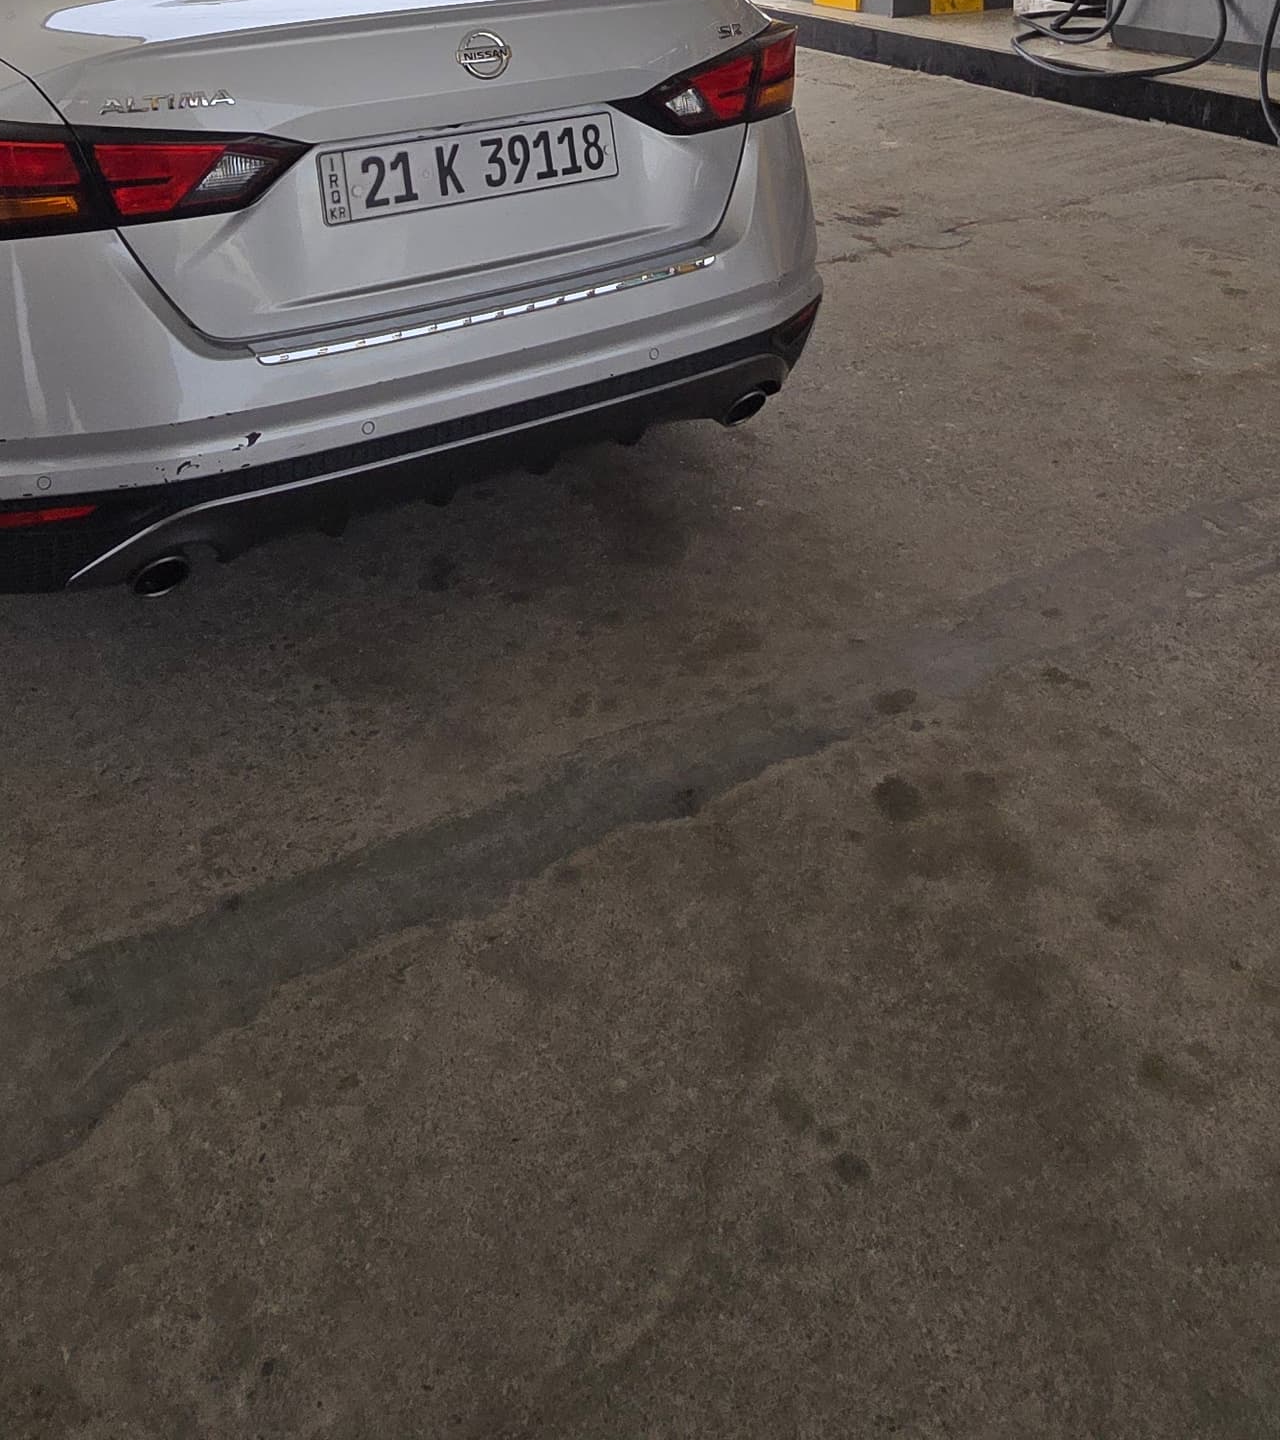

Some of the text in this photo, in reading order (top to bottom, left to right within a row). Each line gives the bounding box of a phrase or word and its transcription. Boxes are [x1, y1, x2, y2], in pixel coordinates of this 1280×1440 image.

[463, 48, 508, 61] NISSAN
[100, 89, 236, 115] ALTIMA
[361, 124, 604, 209] 21 K 39118
[329, 207, 346, 220] KR
